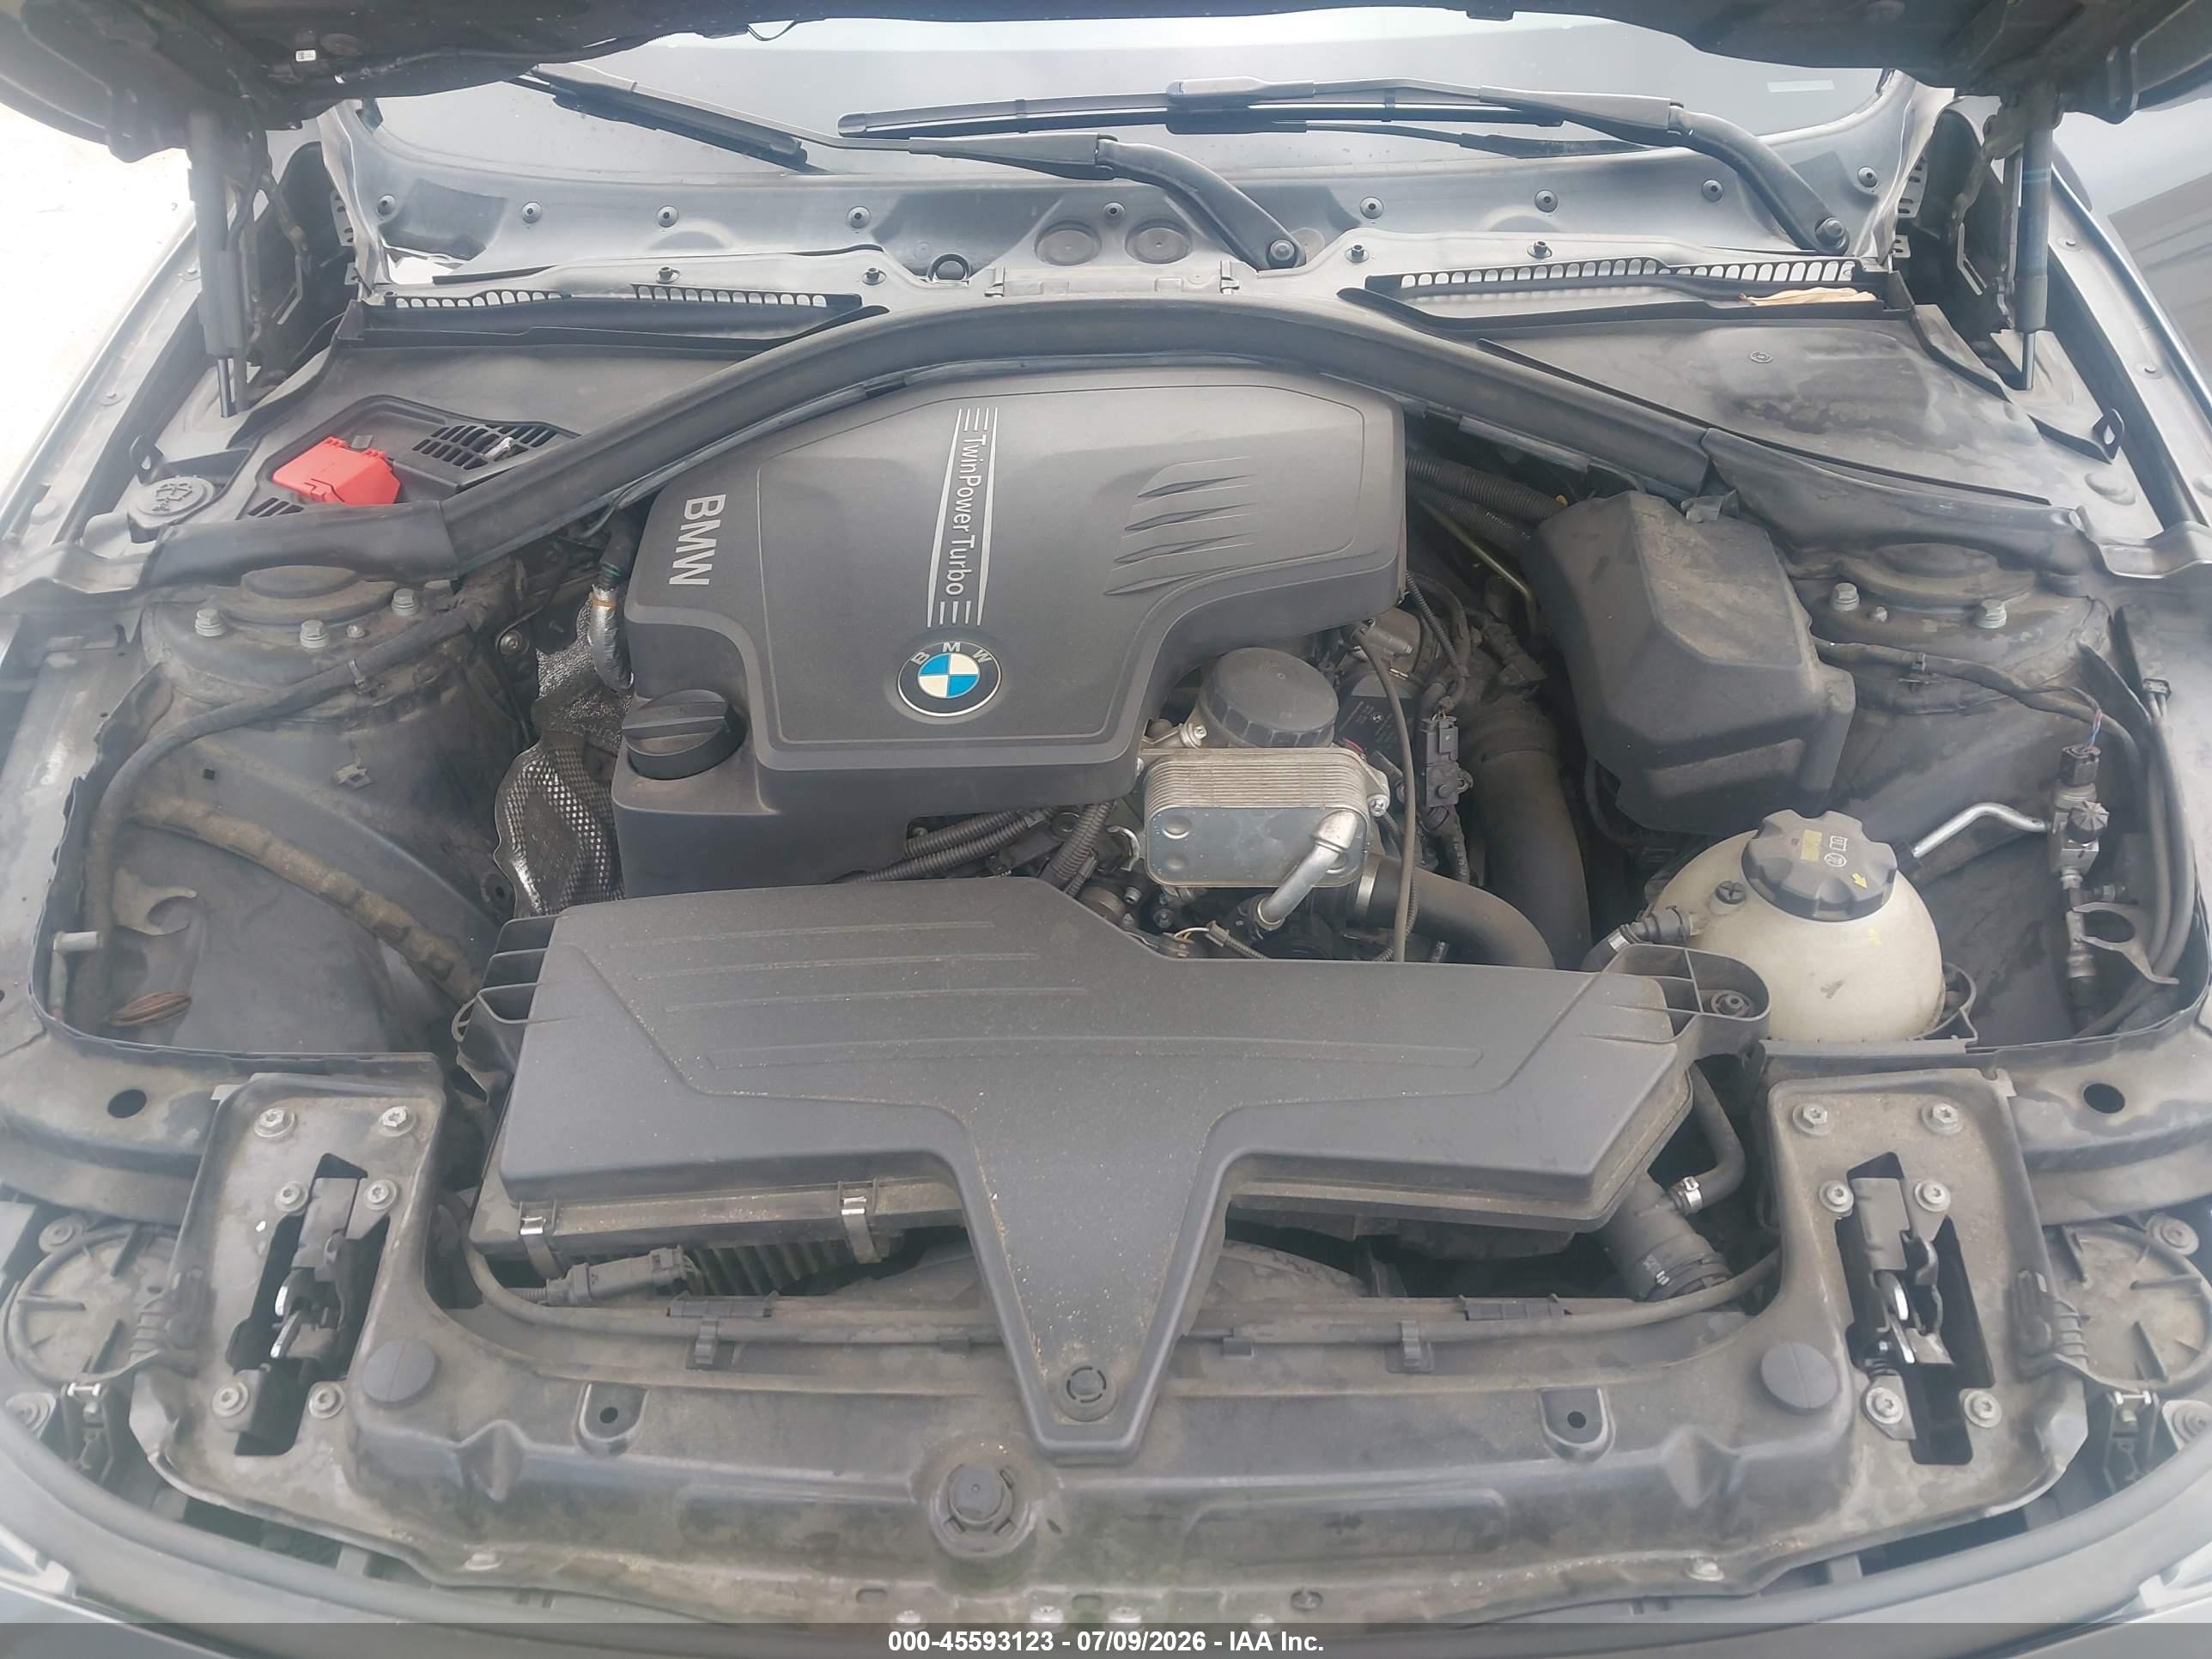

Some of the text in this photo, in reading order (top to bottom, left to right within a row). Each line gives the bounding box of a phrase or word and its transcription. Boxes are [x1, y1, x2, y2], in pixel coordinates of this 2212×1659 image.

[669, 494, 726, 585] BMW
[945, 434, 987, 595] TwinPower Turbo
[910, 641, 993, 665] BMW
